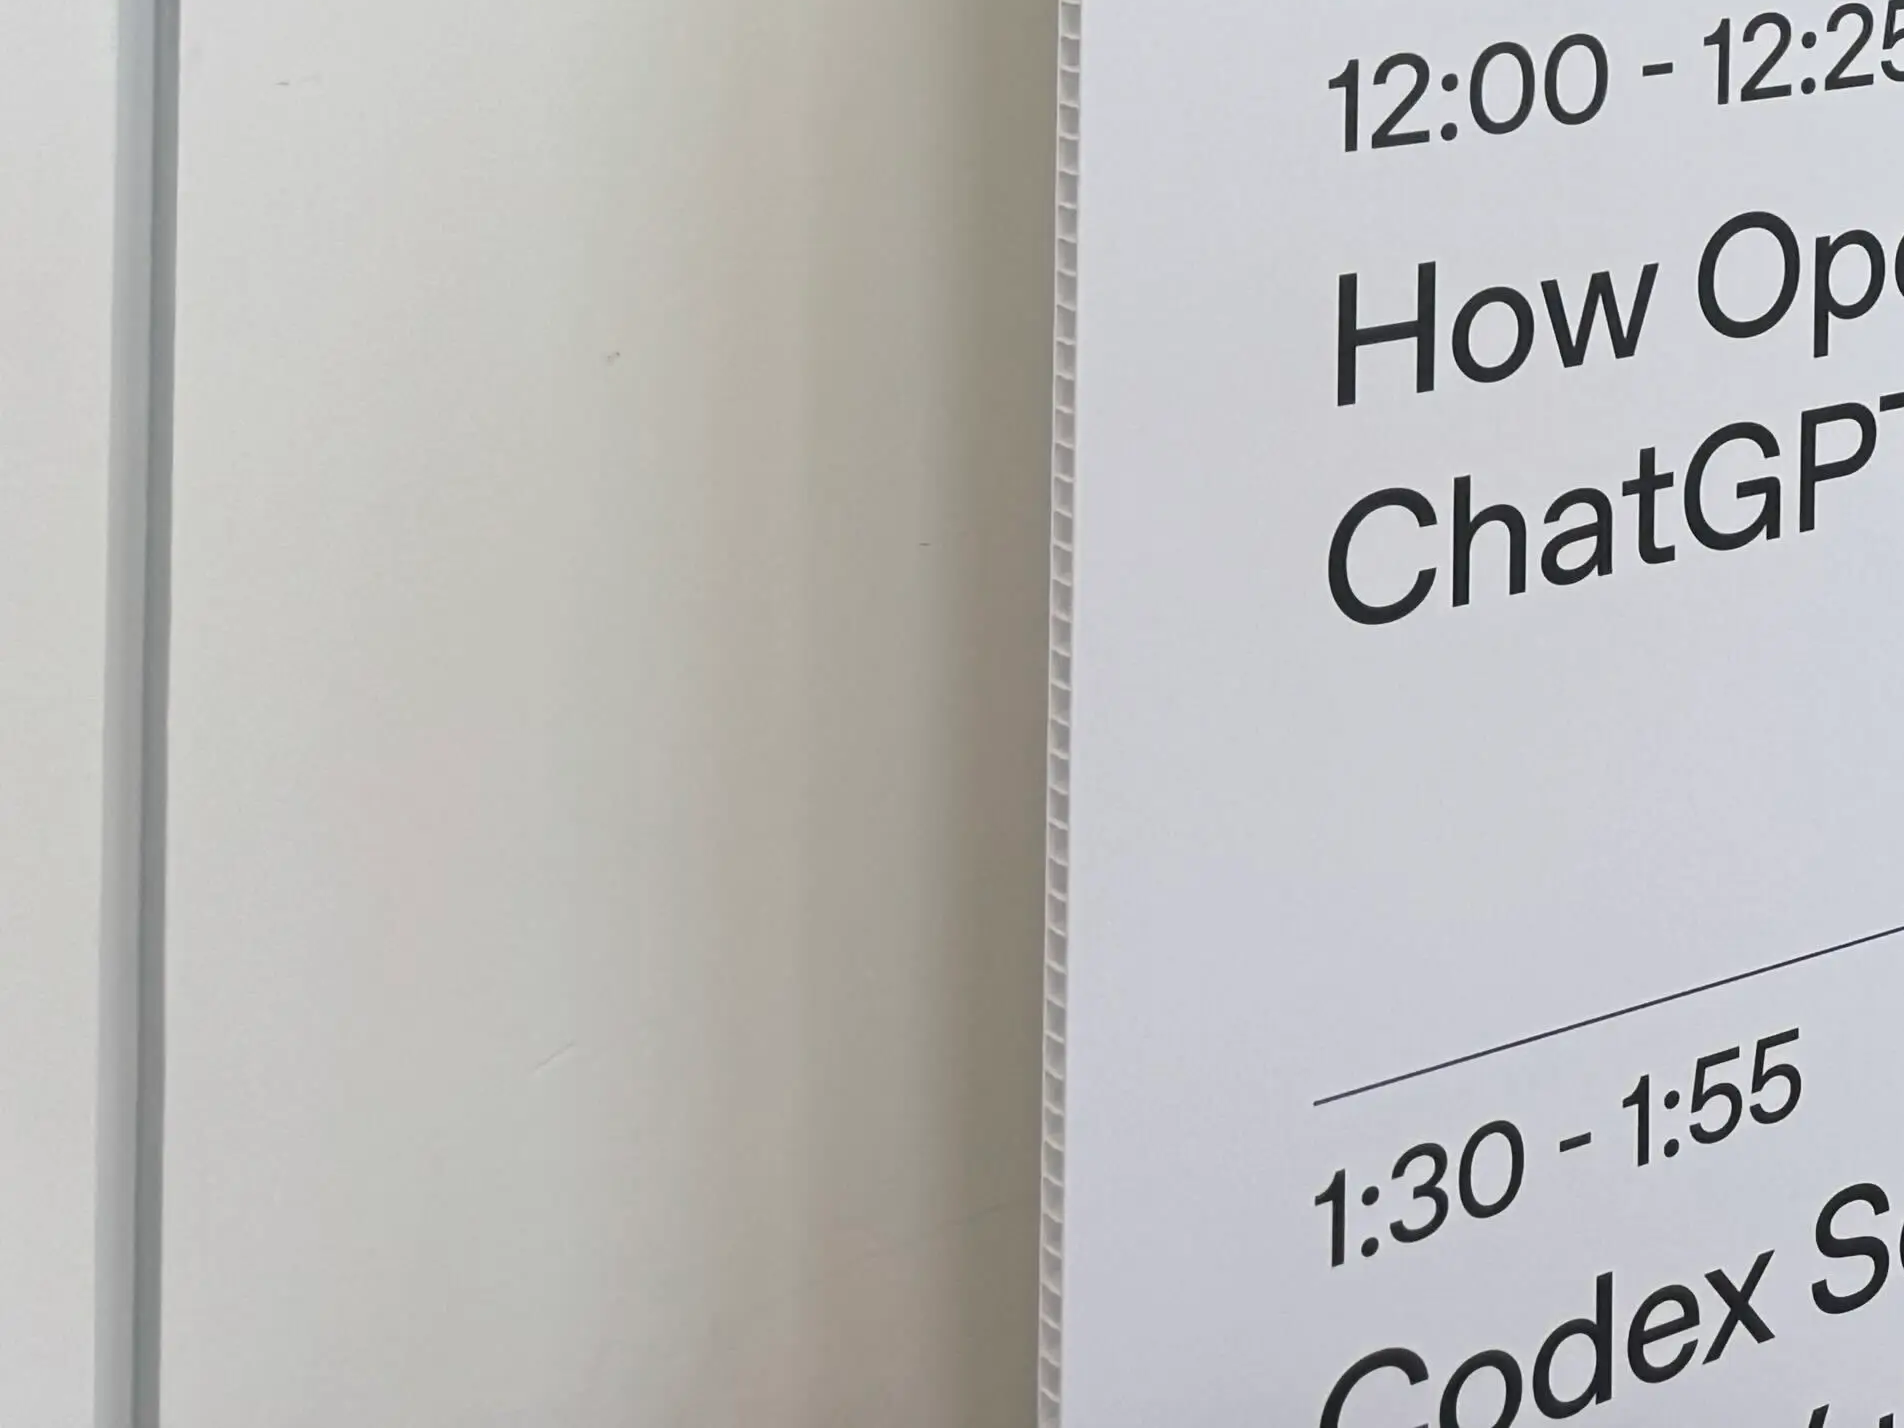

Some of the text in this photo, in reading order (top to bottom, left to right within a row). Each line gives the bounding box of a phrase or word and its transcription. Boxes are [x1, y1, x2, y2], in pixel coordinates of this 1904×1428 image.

[1327, 32, 1610, 154] 12:00
[1641, 61, 1675, 78] -
[1336, 259, 1660, 408] How
[1313, 1026, 1803, 1269] 1:30 - 1:55
[1318, 1248, 1777, 1428] Codex
